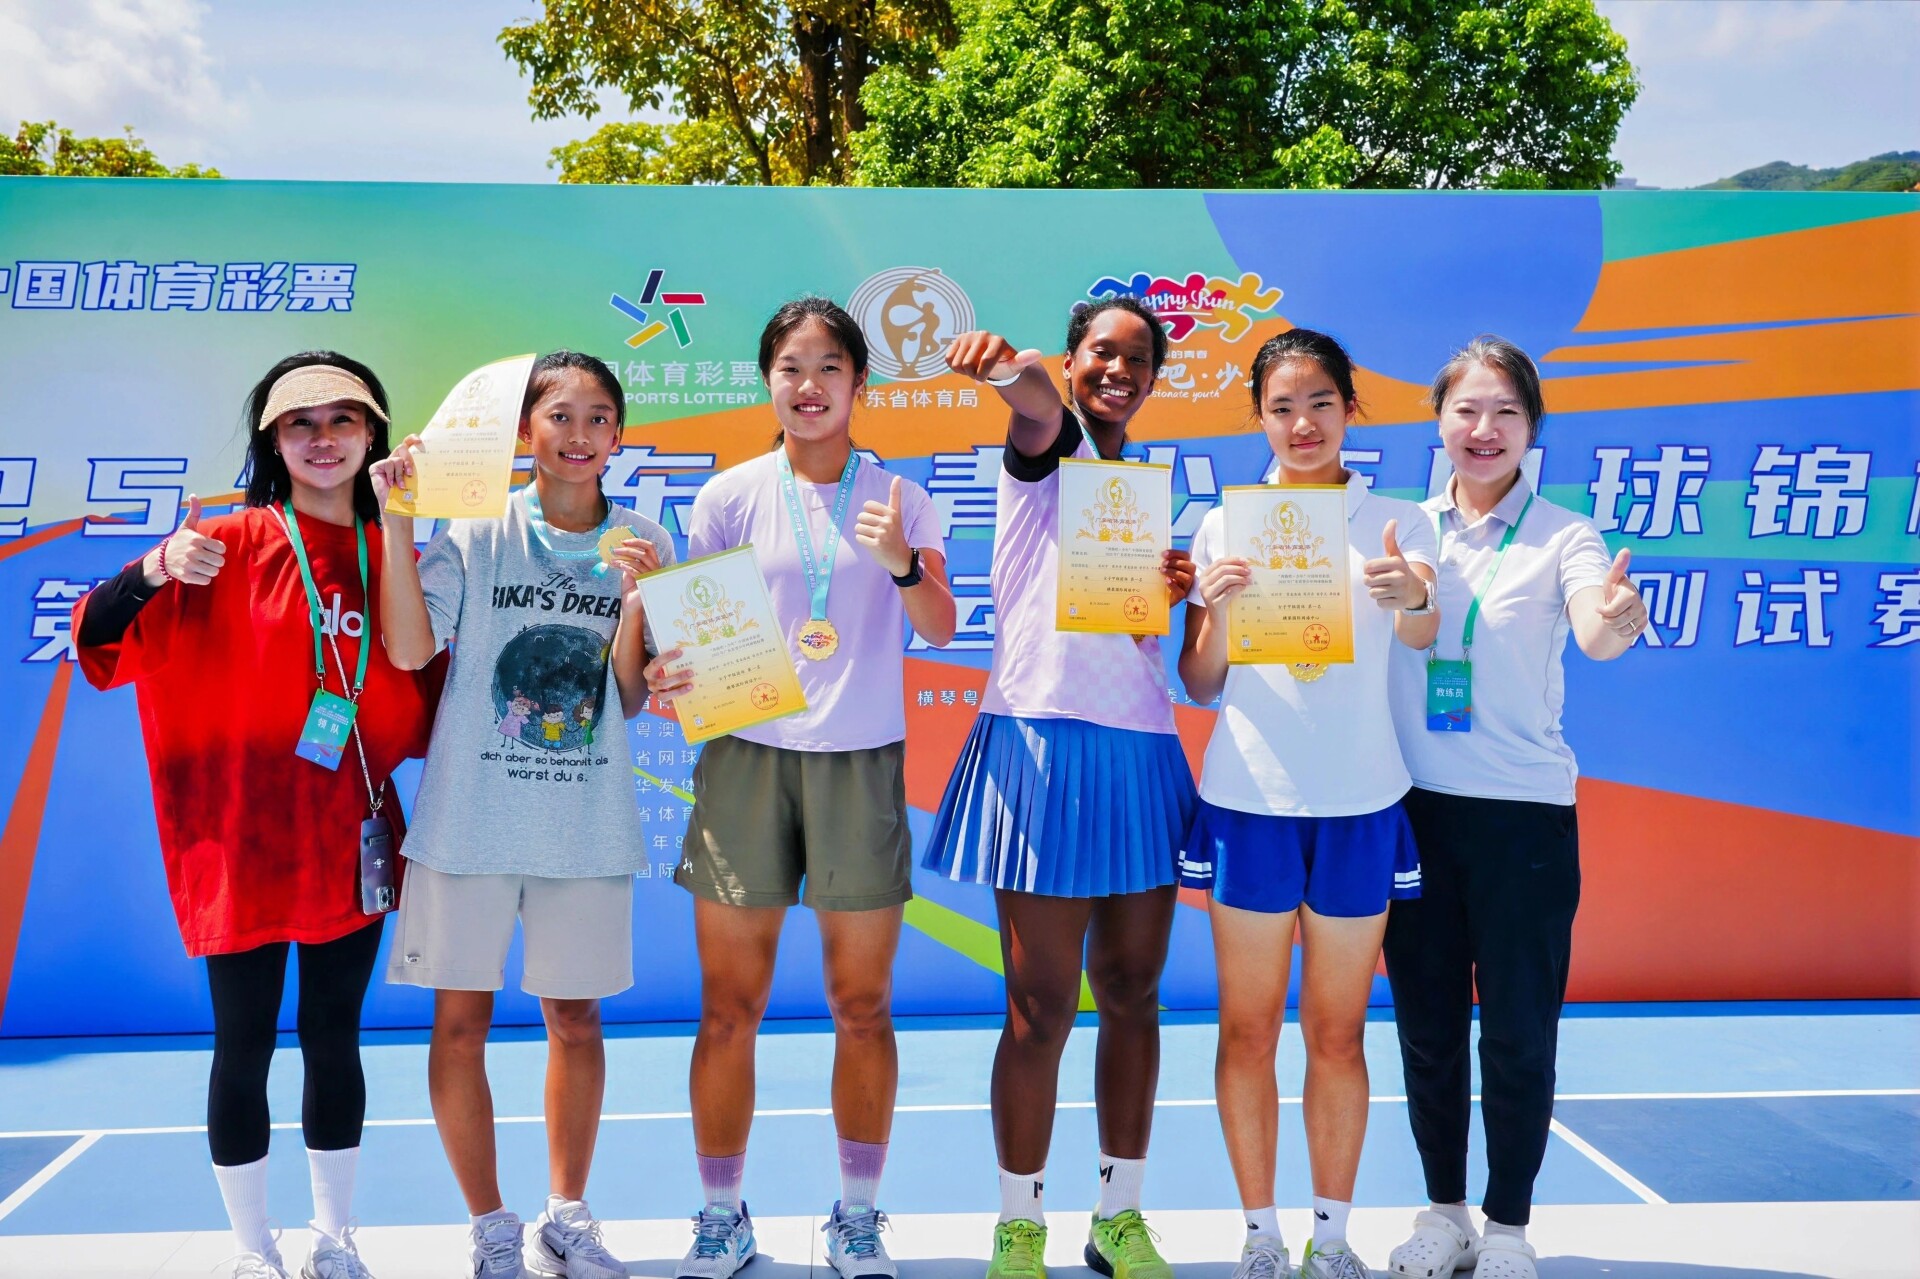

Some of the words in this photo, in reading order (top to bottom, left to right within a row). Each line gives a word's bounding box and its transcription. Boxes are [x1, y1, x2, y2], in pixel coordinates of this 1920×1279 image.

[0, 260, 357, 312] 国体育彩票
[1189, 286, 1236, 310] Run
[602, 359, 759, 387] 体育彩票
[623, 391, 679, 405] PORTS
[683, 391, 759, 405] LOTTERY
[860, 388, 978, 409] 东省体育局
[1192, 389, 1220, 403] youth
[541, 572, 577, 592] The
[561, 592, 621, 620] DREA
[309, 592, 364, 637] alo
[917, 690, 979, 707] 横琴粤
[1435, 687, 1464, 698] 教练员
[624, 722, 684, 738] 粤澳
[1446, 722, 1452, 730] 2
[314, 753, 321, 762] 2
[480, 751, 502, 761] dich
[505, 753, 532, 763] aber
[535, 756, 548, 765] so
[636, 750, 697, 766] 省网球
[507, 766, 550, 781] wärst
[554, 769, 572, 782] du
[636, 778, 694, 794] 华发体
